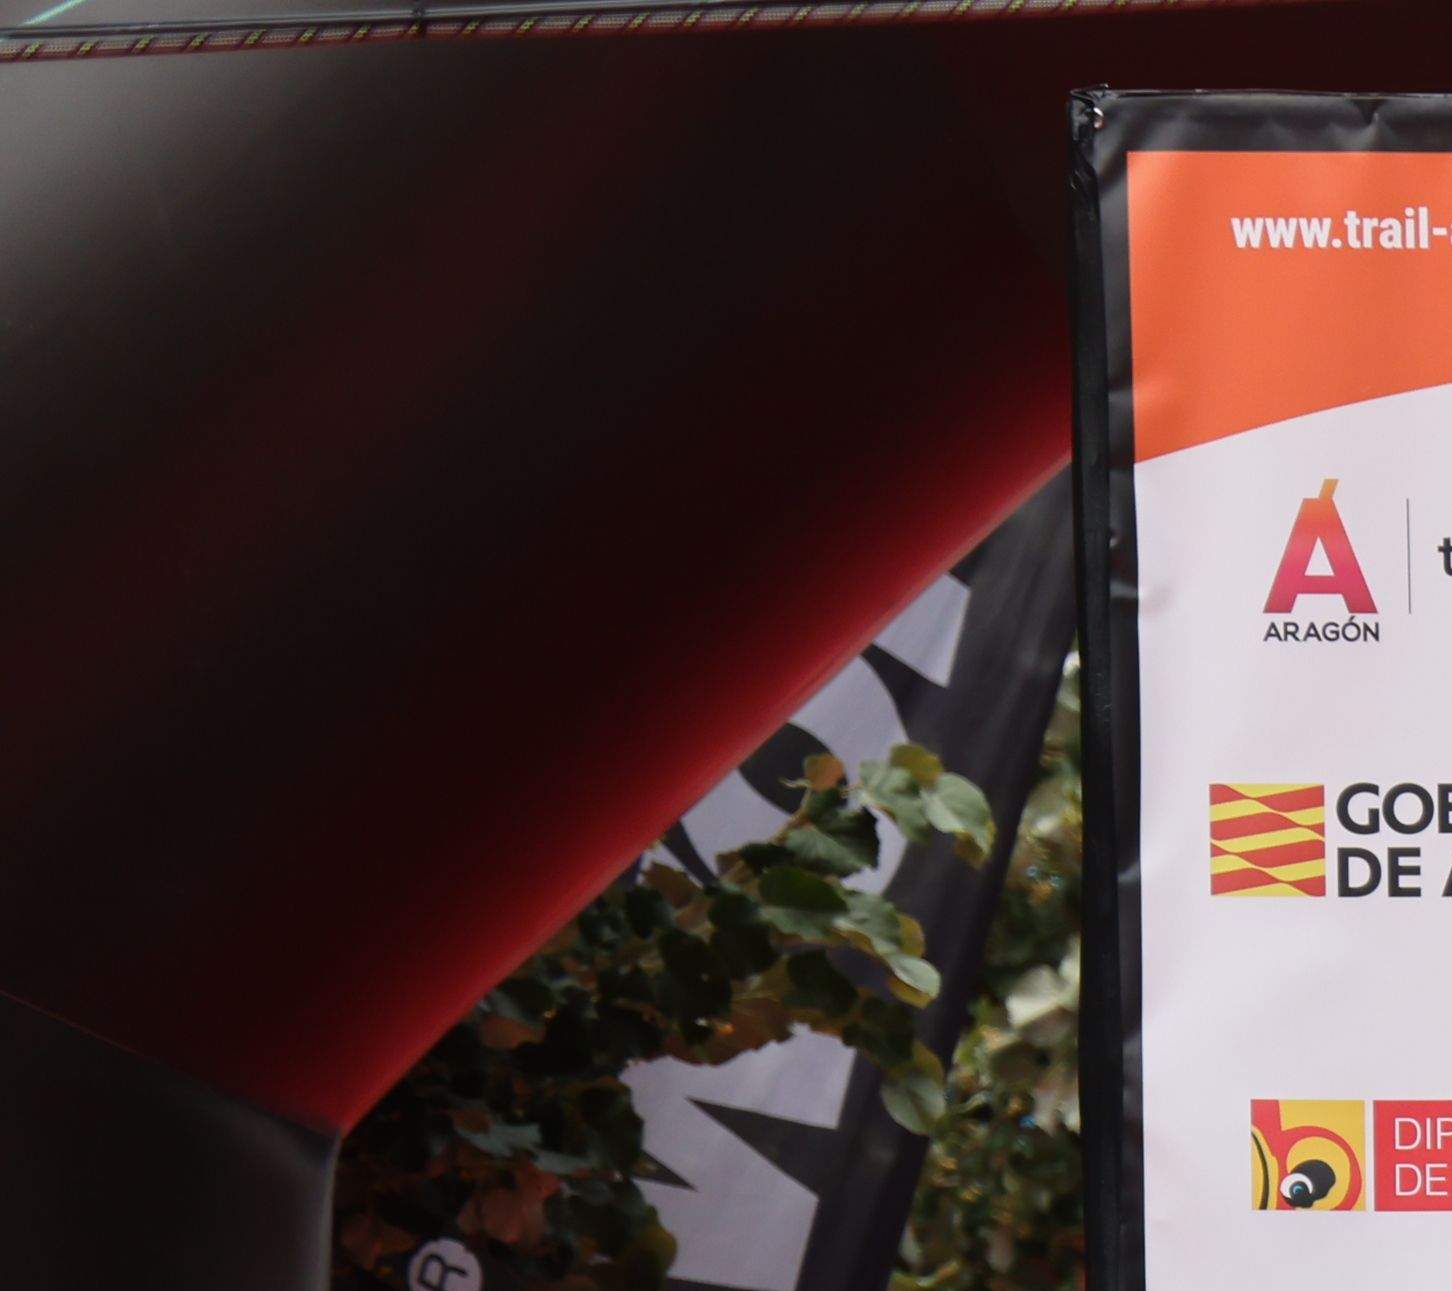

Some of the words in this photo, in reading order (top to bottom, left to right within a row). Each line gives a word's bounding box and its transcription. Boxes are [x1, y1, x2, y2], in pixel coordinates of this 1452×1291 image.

[1263, 617, 1380, 643] ARAGÓN
[1337, 847, 1421, 898] DE
[1394, 1164, 1448, 1196] DE
